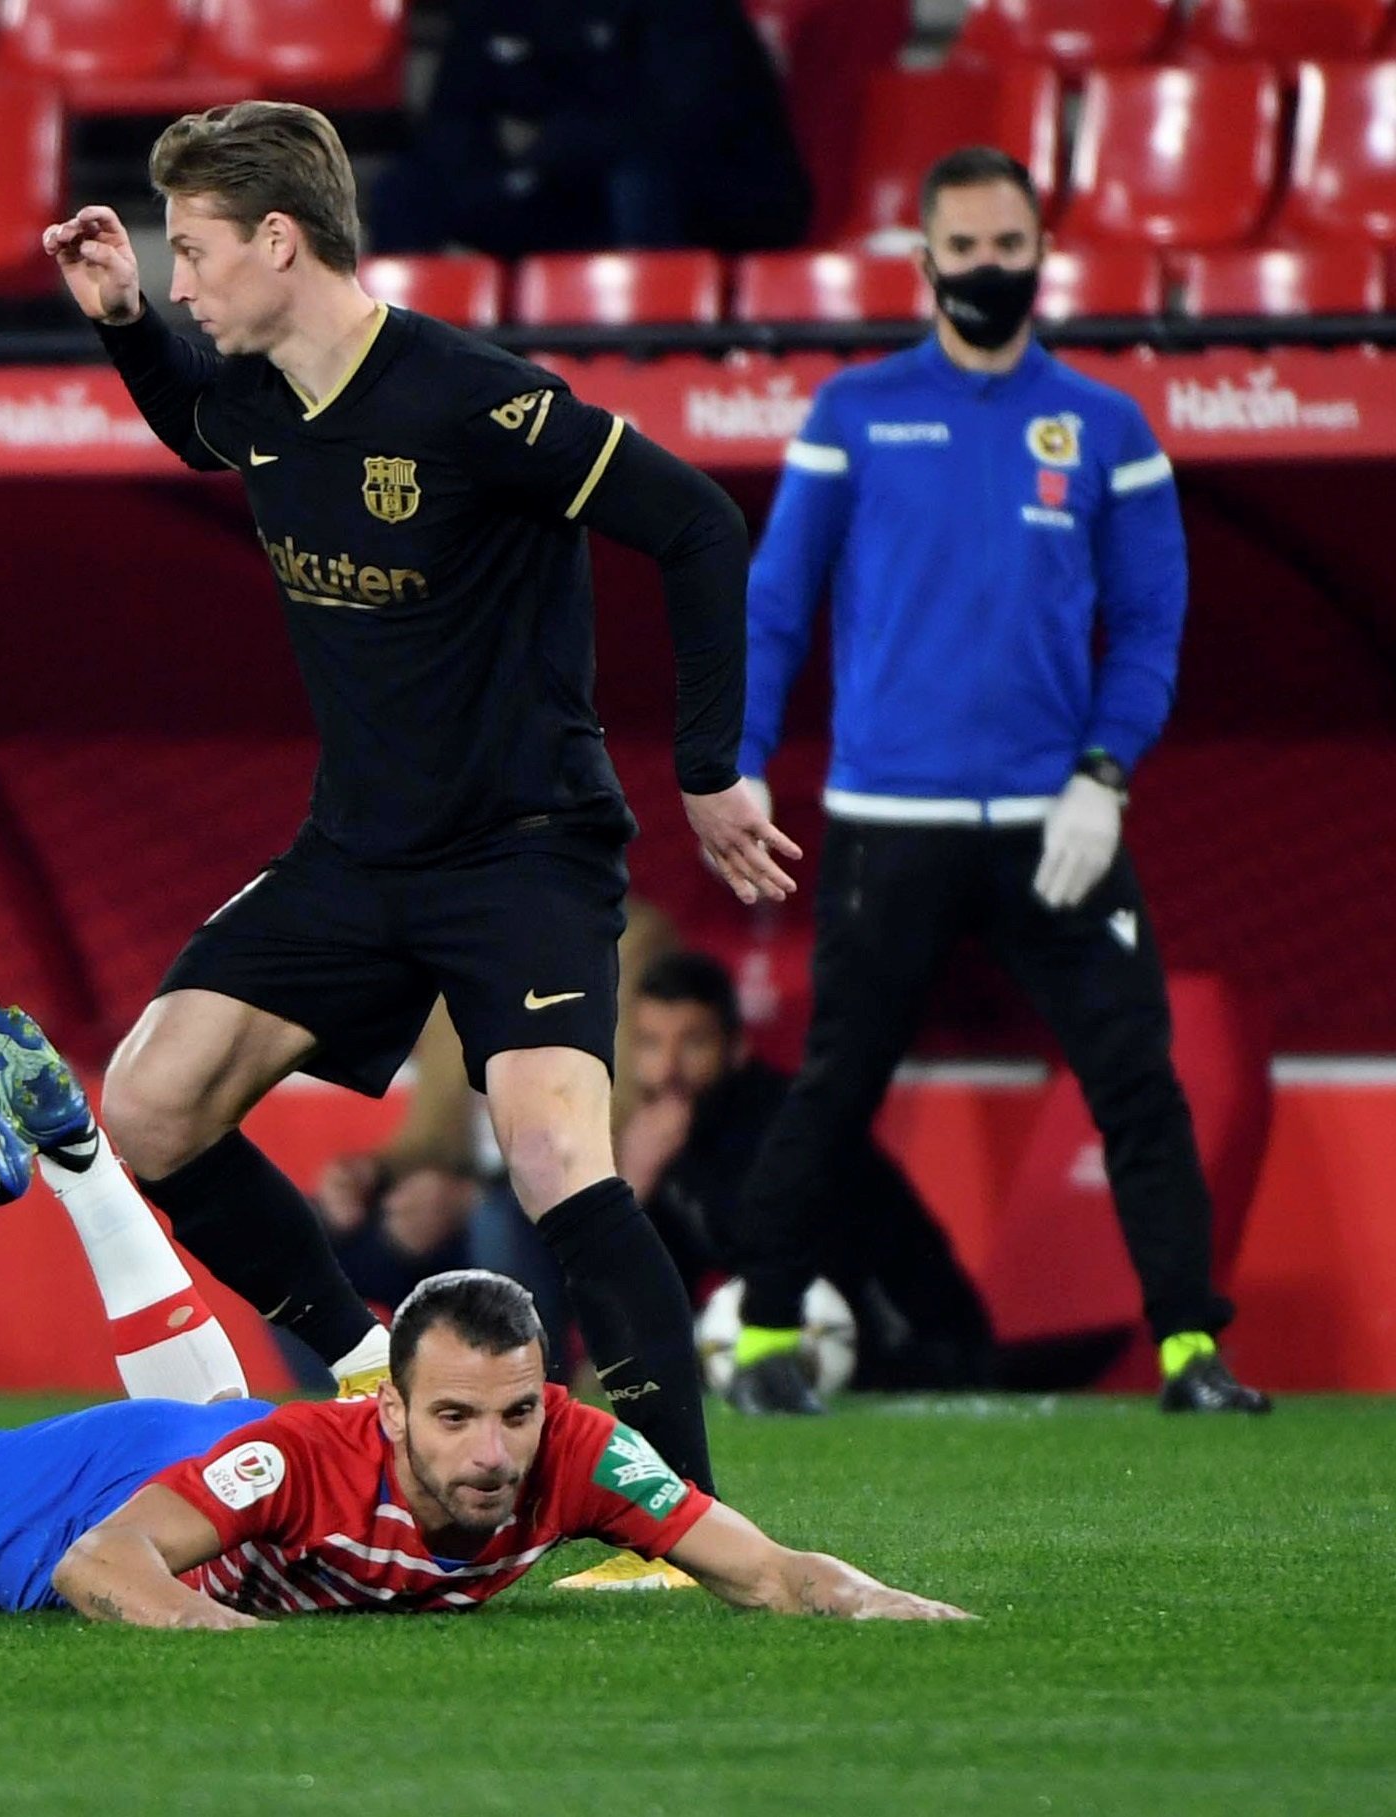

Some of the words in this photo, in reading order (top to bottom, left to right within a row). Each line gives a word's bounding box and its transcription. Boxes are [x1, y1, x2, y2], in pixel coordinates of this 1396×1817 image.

[490, 389, 544, 430] be
[256, 526, 431, 606] akuten
[606, 1380, 661, 1401] ARÇA
